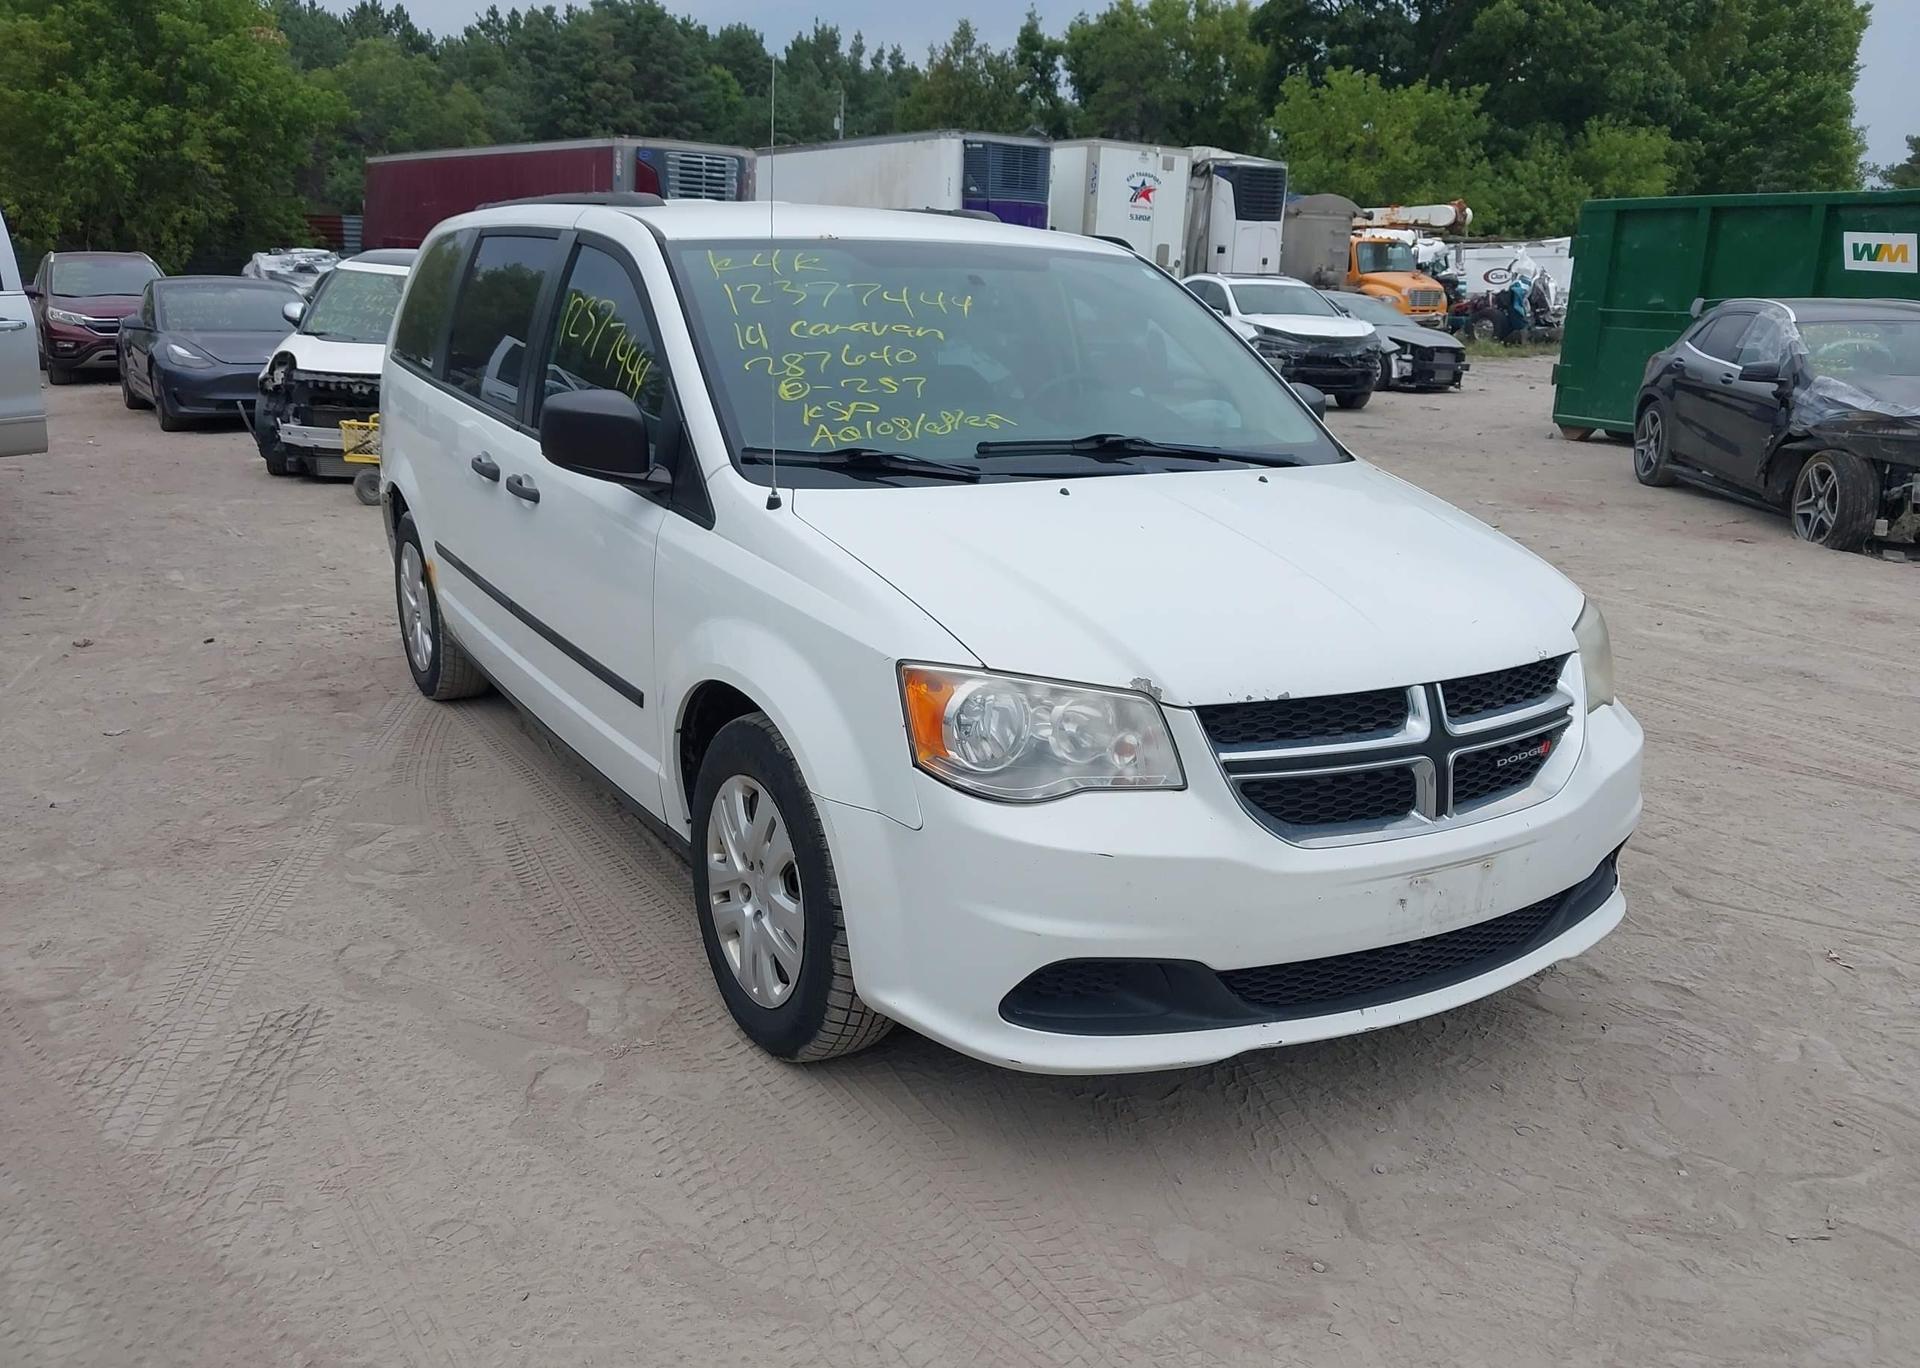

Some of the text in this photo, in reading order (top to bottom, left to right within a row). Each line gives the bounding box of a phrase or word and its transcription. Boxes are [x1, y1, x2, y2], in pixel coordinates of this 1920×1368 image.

[1852, 242, 1908, 263] WM
[734, 322, 769, 350] 14
[1496, 745, 1545, 768] DODGE
